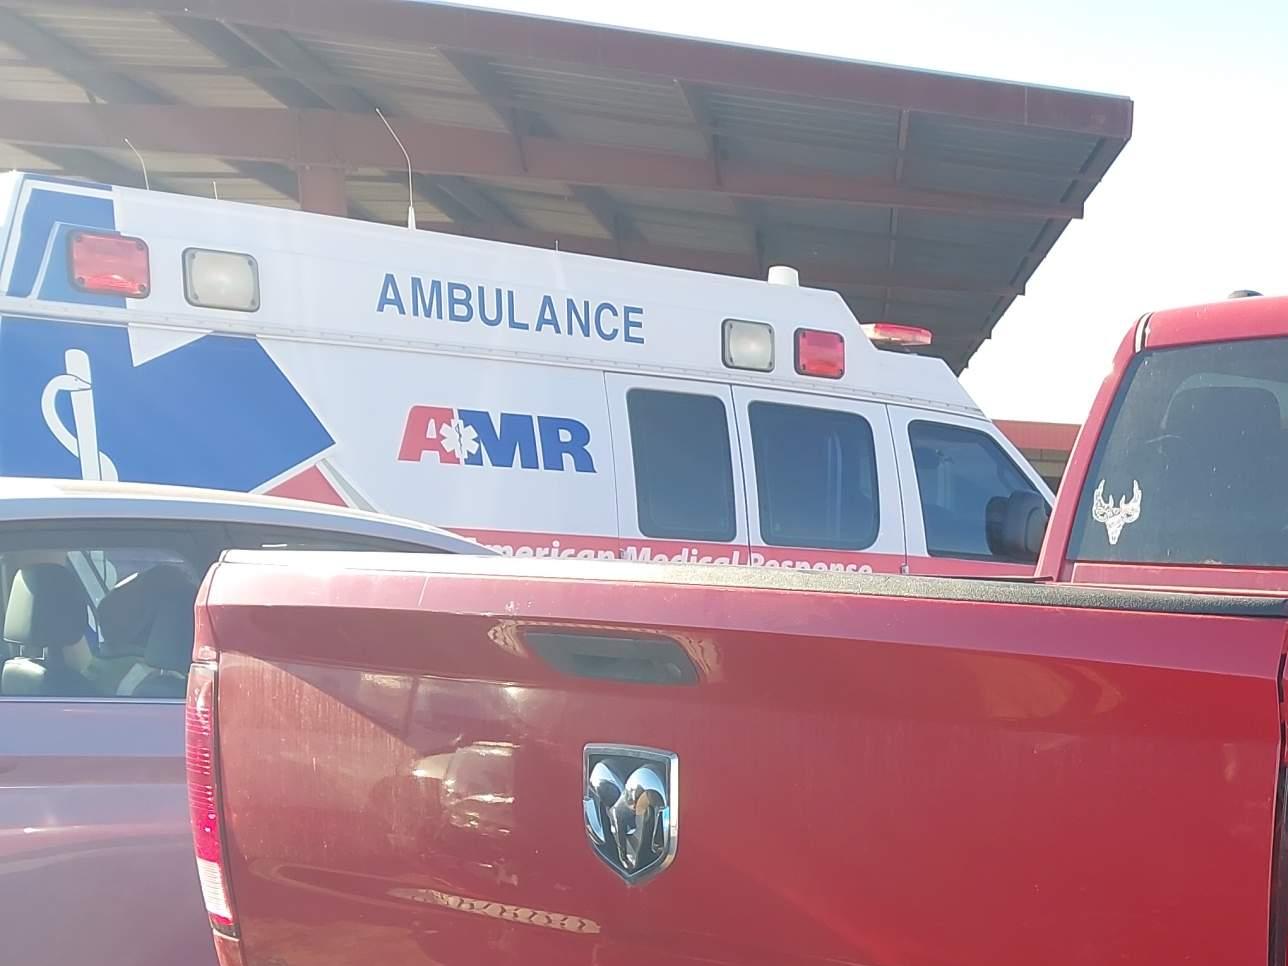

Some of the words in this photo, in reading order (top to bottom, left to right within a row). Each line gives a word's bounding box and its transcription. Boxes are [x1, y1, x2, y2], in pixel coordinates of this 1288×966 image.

[376, 273, 645, 344] AMBULANCE
[397, 405, 597, 473] AMR
[462, 536, 616, 560] merican
[622, 546, 740, 566] Medical
